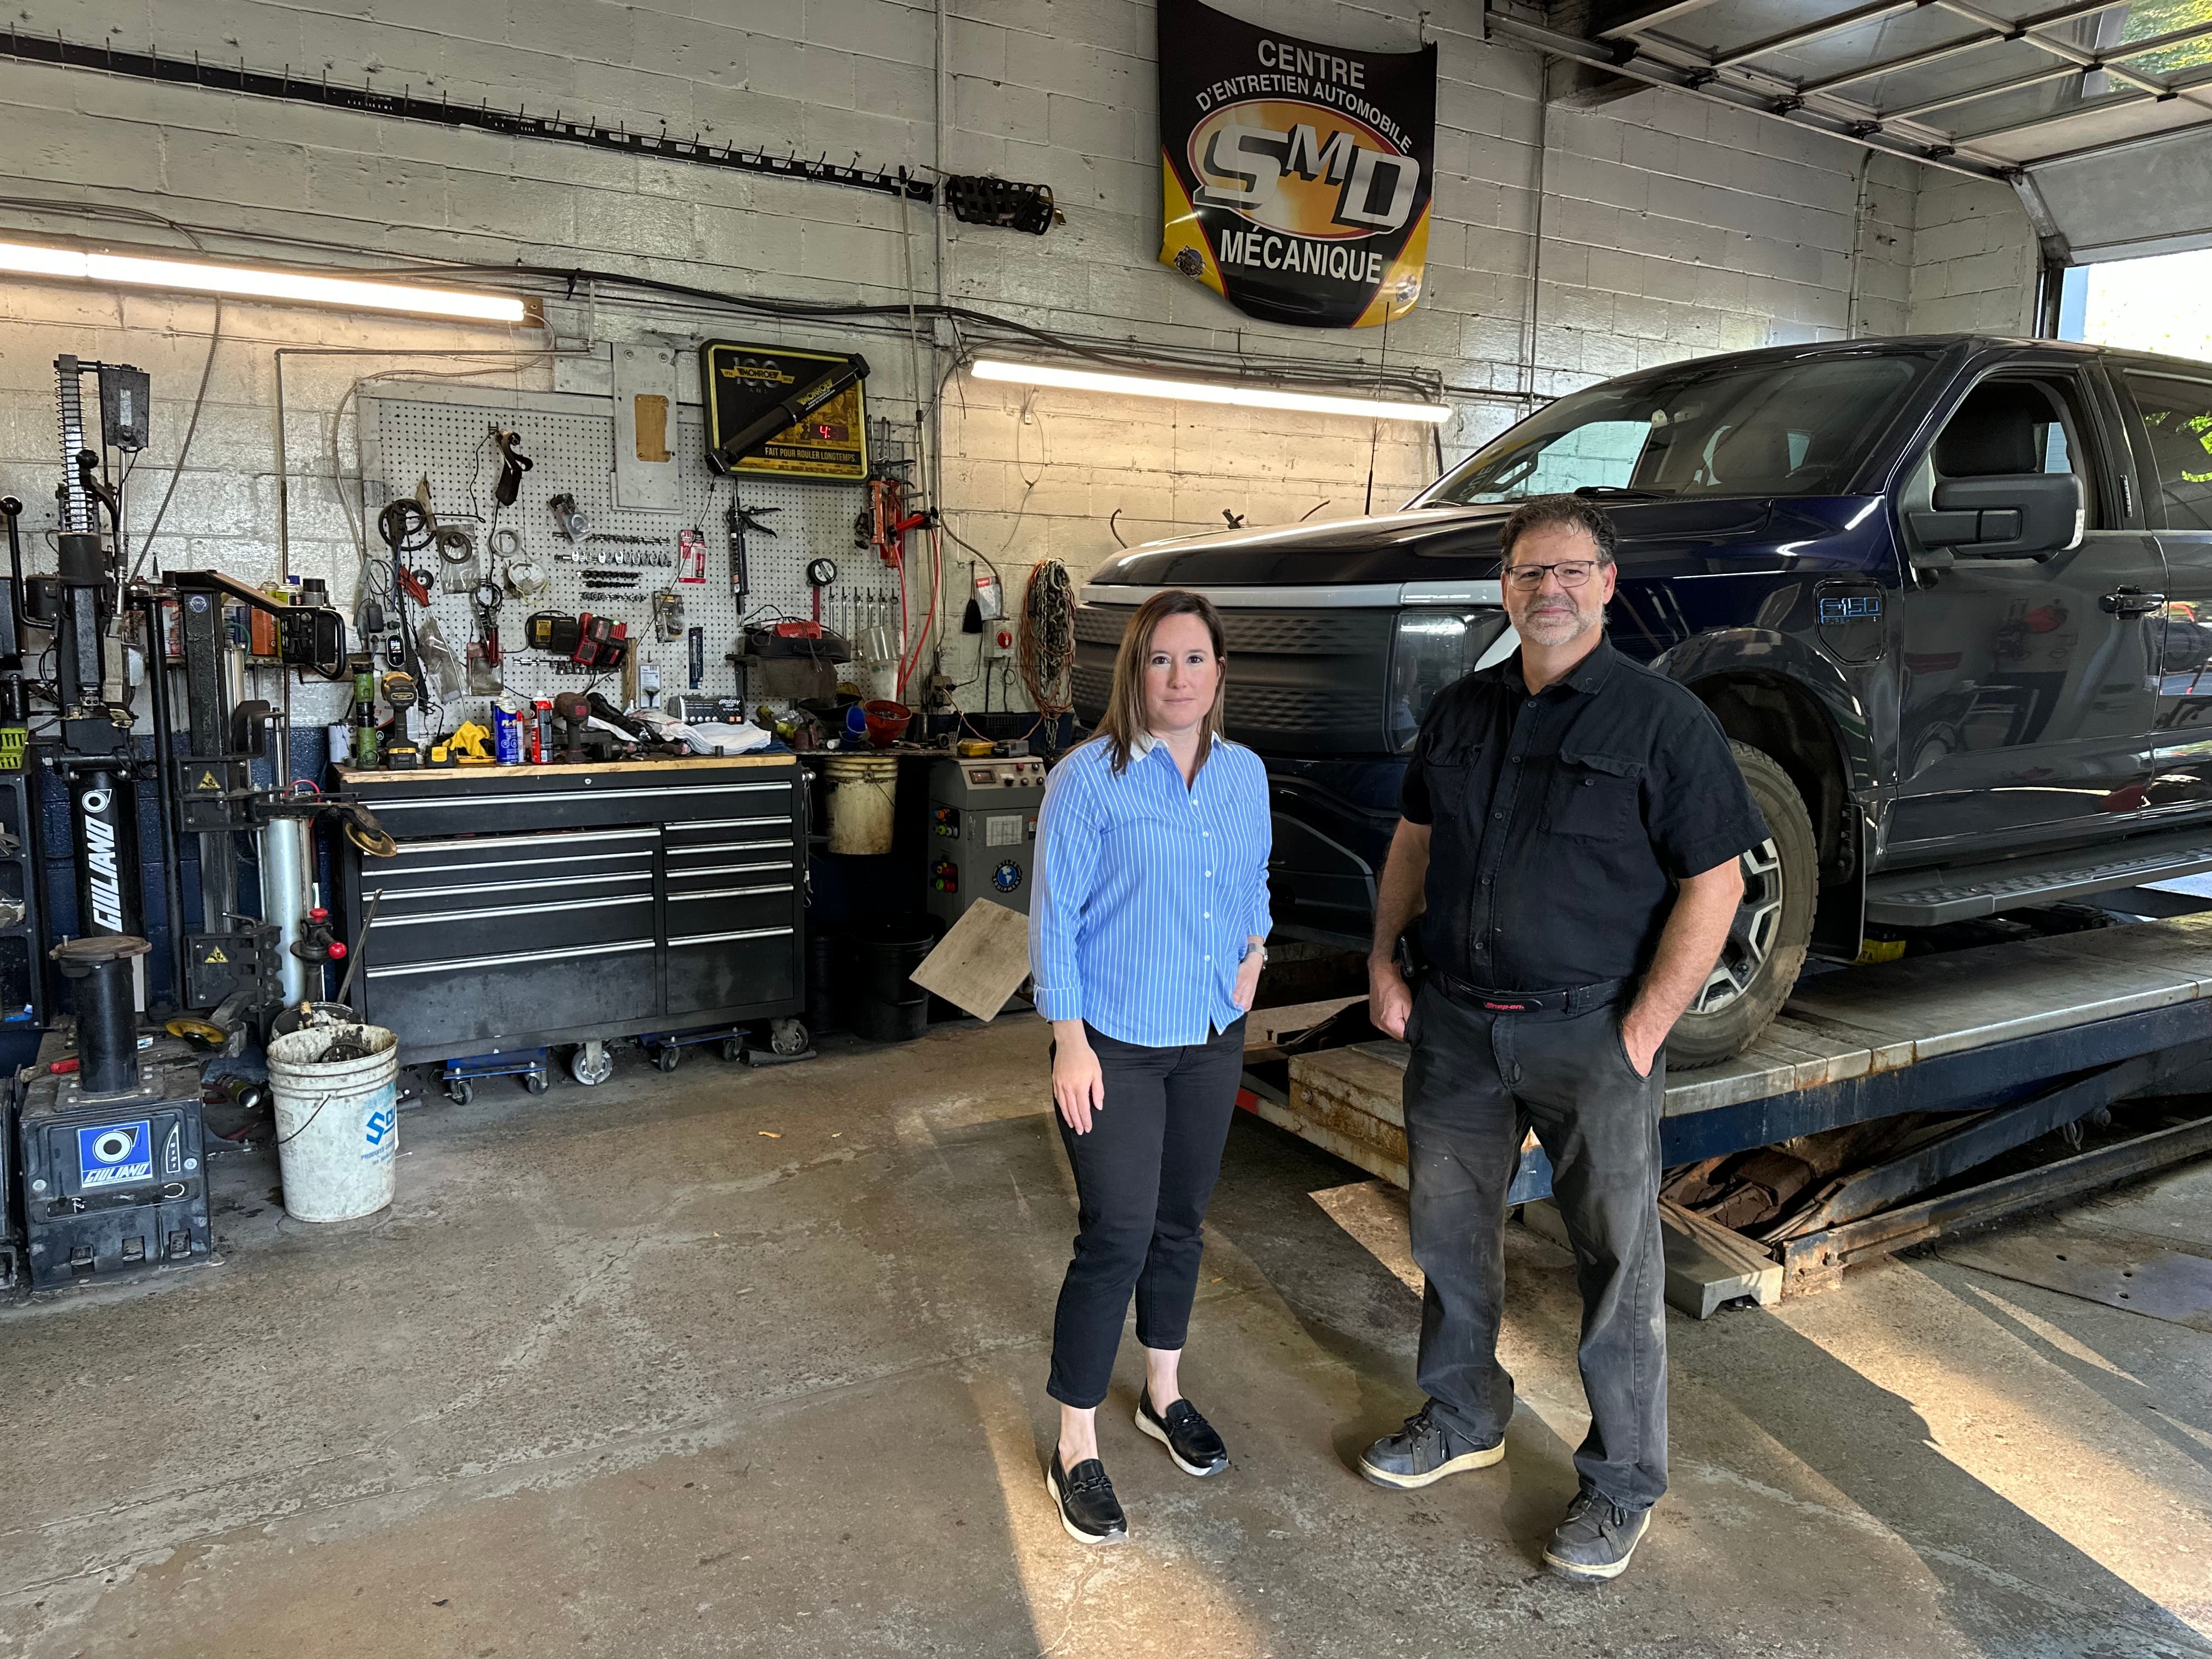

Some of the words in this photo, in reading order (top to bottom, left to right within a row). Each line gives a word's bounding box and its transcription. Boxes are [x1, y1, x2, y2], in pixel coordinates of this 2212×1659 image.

[1258, 39, 1365, 89] CENTRE
[1195, 74, 1309, 111] D'ENTRETIEN
[1313, 84, 1412, 154] AUTOMOBILE
[1201, 123, 1419, 228] SMD
[1220, 225, 1383, 284] MÉCANIQUE
[737, 368, 779, 379] MONROE
[795, 378, 833, 405] MONROE
[765, 447, 778, 456] FAIT
[780, 448, 795, 458] POUR
[797, 449, 820, 459] ROULER
[821, 452, 857, 462] LONGTEMPS.
[1820, 597, 1881, 617] F-150
[85, 815, 123, 932] GIULIANO
[993, 877, 1021, 891] EQUIPMENT
[83, 1161, 150, 1184] GIULIANO
